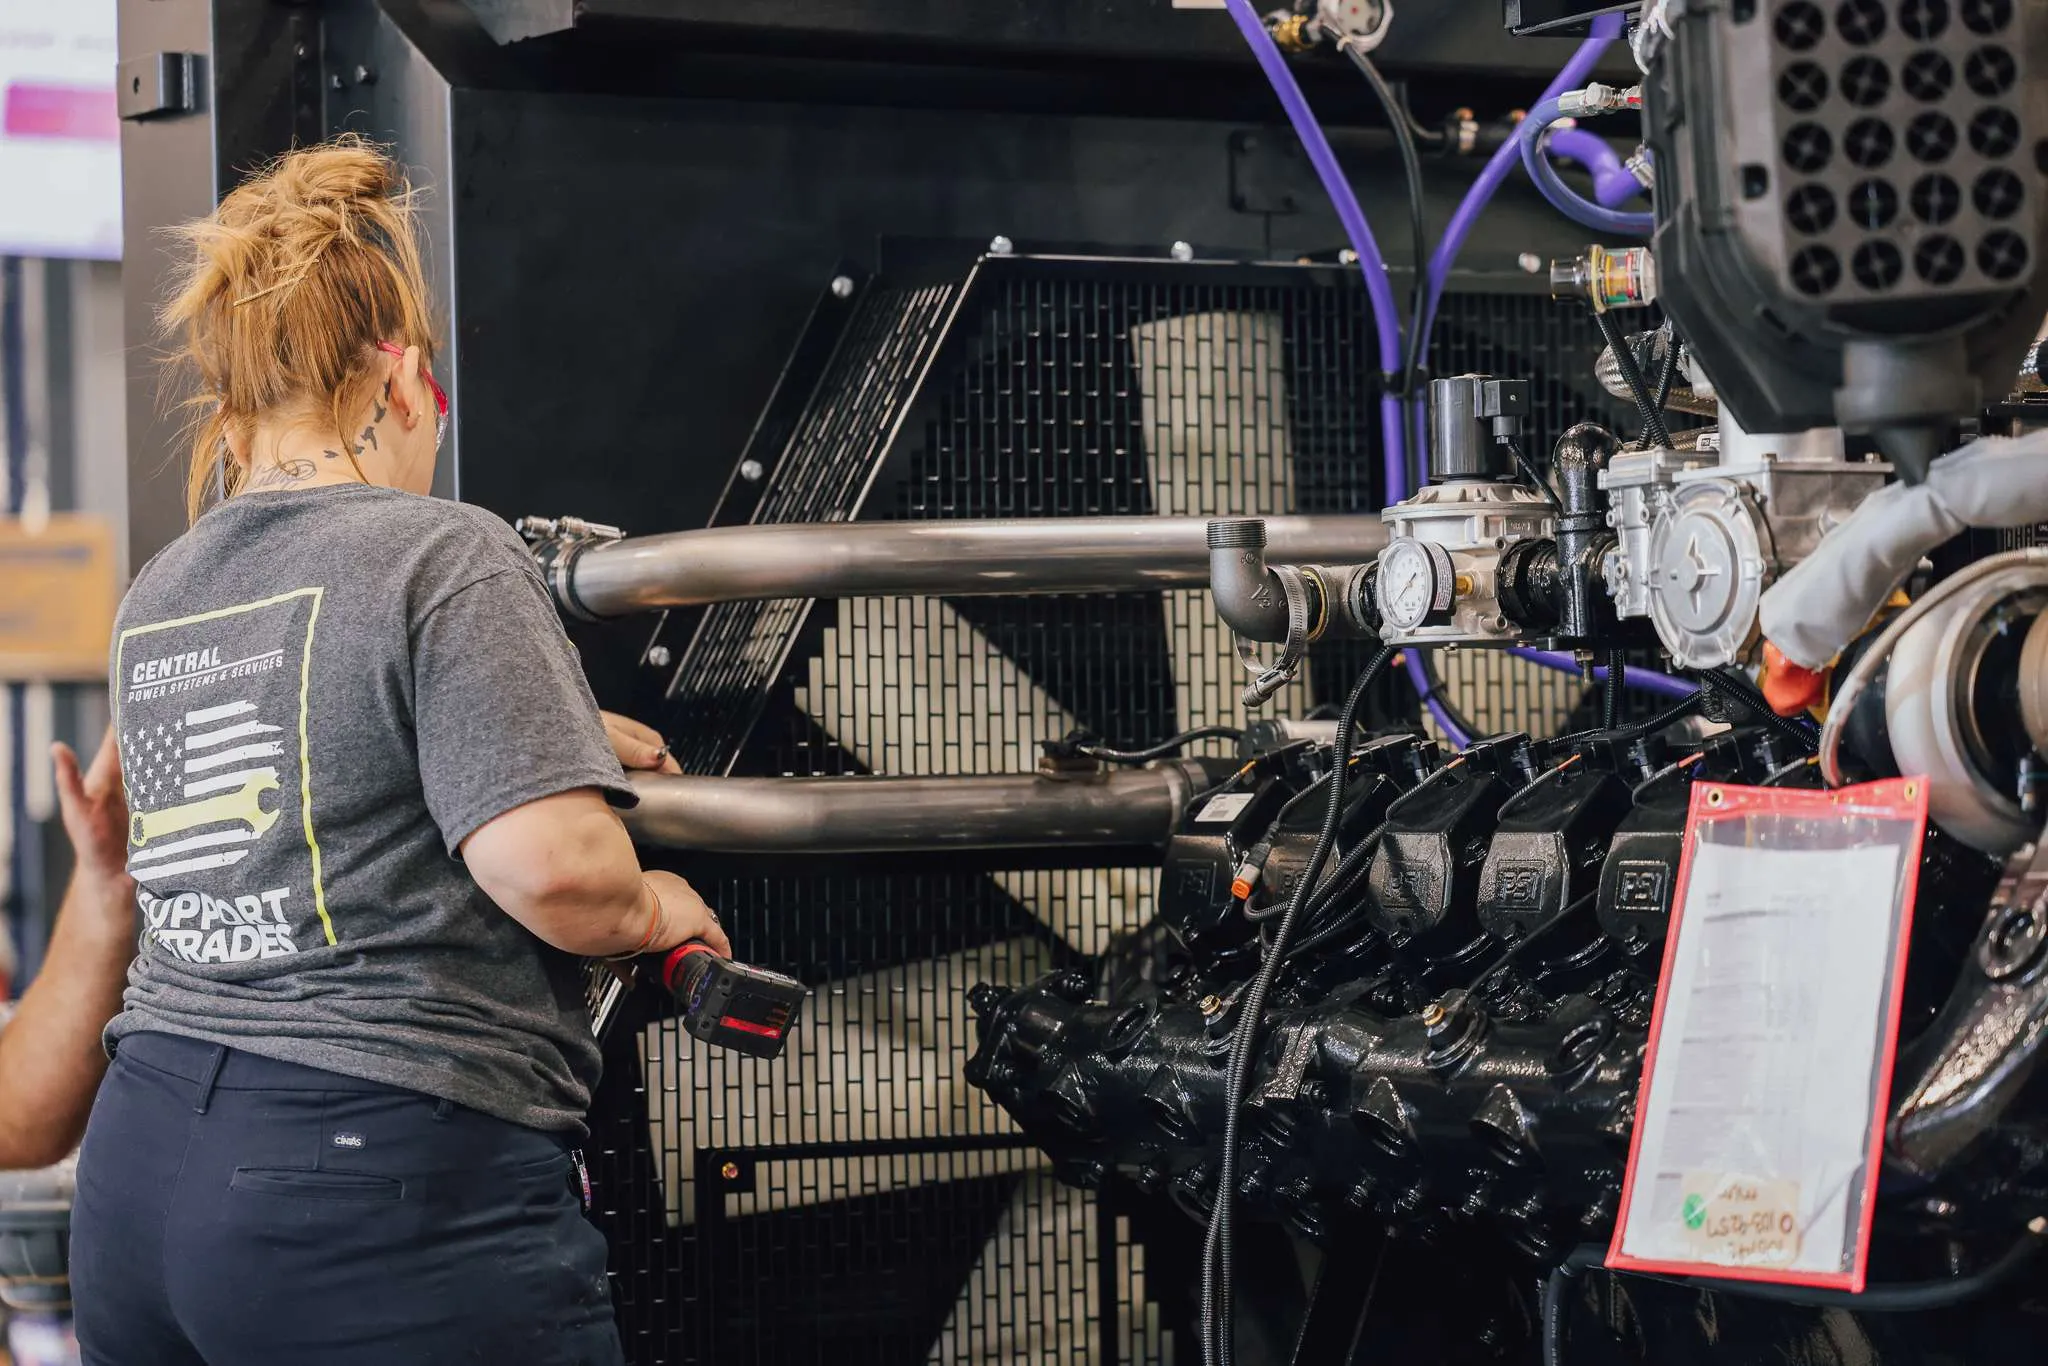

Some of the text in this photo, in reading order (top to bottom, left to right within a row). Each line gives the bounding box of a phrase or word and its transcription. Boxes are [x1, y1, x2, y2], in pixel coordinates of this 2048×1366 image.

[128, 655, 283, 703] POWER SYSTEMS & SERVICES
[132, 646, 222, 684] CENTRAL
[138, 887, 290, 930] SUPPORT
[158, 923, 299, 963] TRADES
